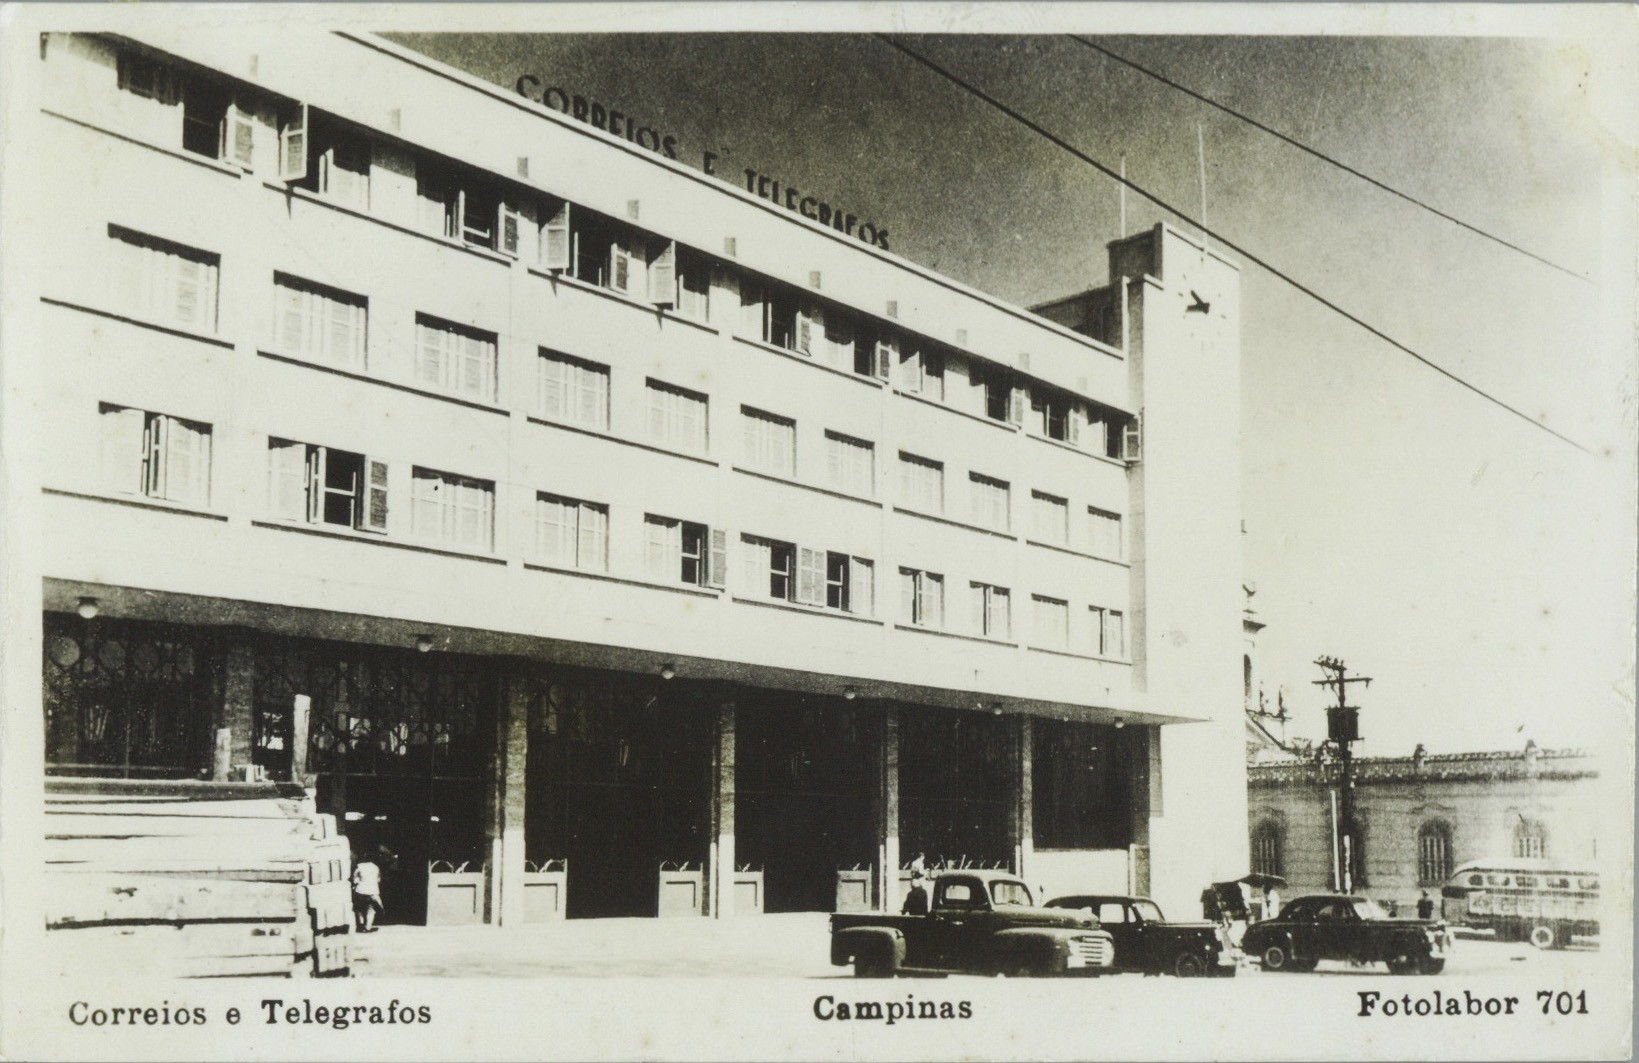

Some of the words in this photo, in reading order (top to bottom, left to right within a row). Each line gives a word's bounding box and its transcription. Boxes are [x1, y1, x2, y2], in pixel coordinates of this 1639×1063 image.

[516, 74, 678, 159] CORREIOS
[703, 151, 718, 175] E
[744, 168, 890, 251] TELEGRAFOS
